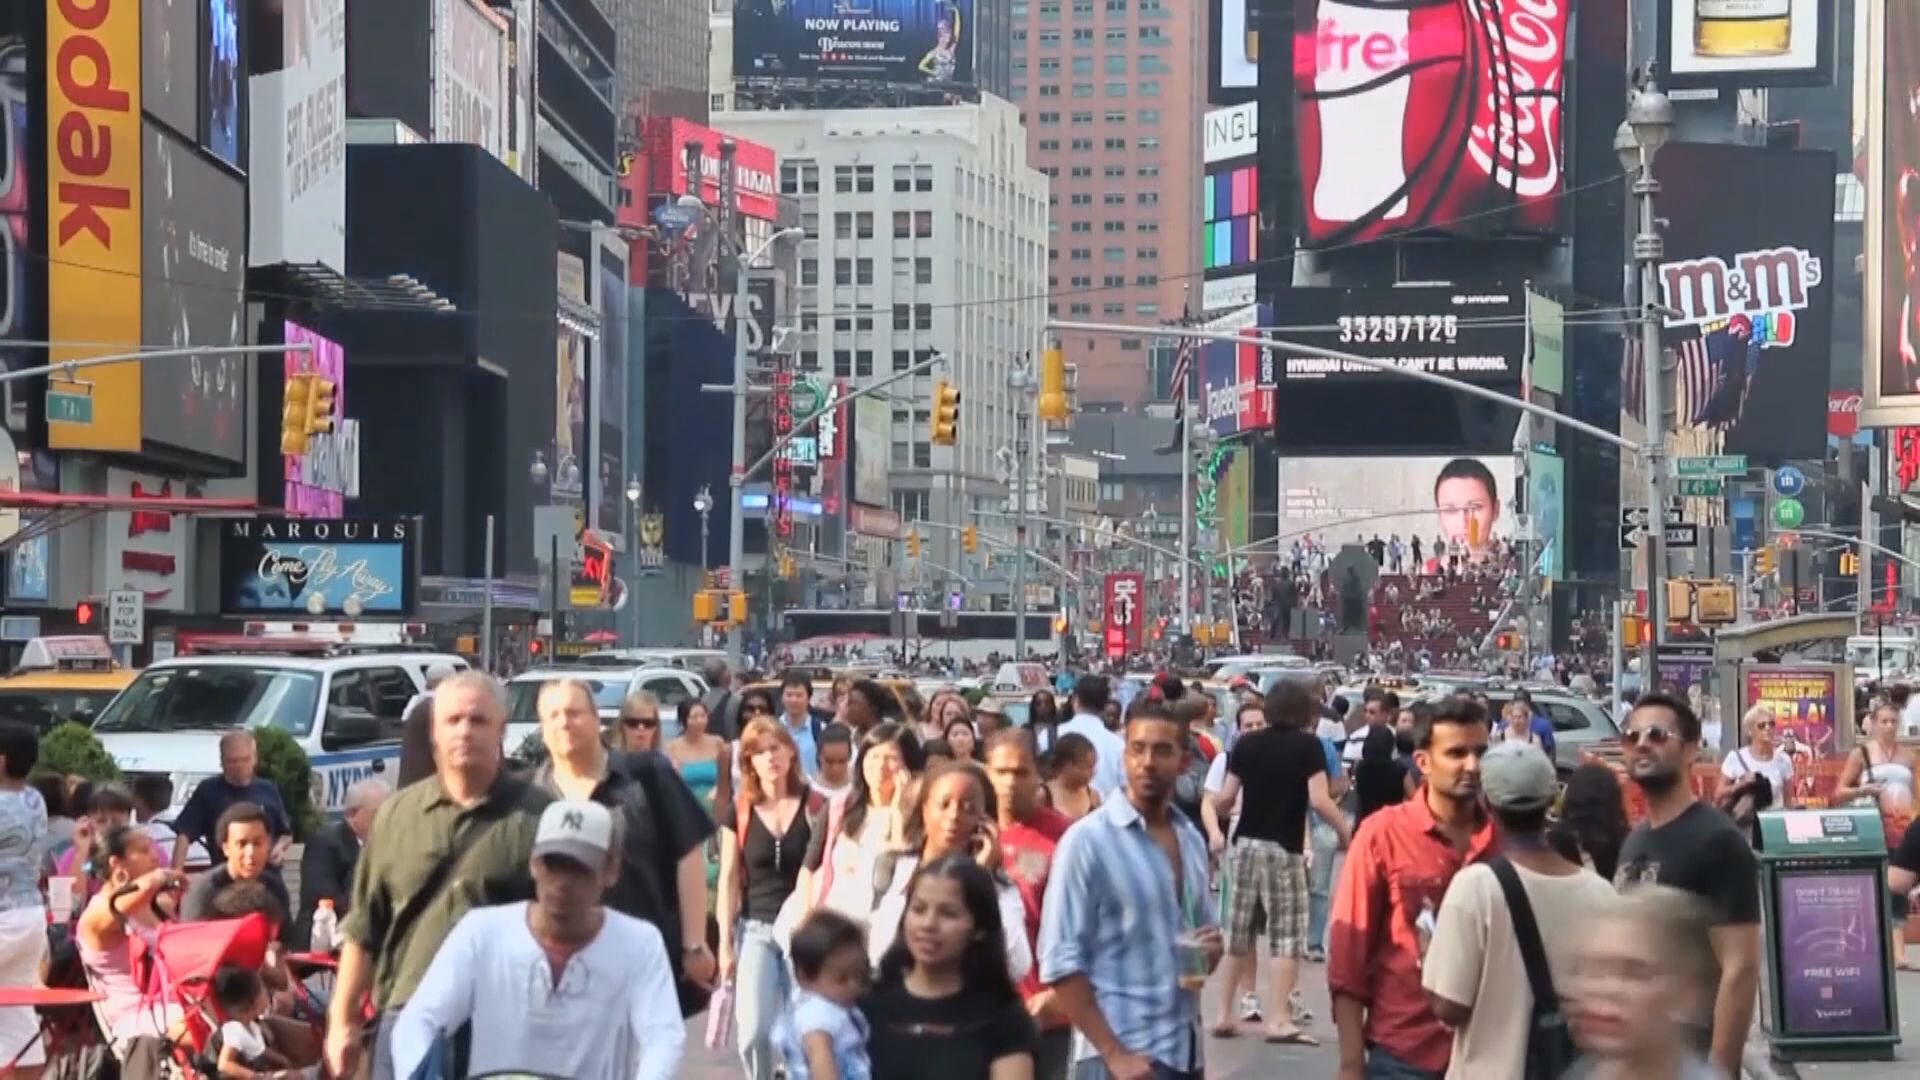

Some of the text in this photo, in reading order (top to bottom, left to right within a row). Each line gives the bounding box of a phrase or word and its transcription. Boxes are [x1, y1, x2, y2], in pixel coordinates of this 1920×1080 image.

[805, 18, 900, 32] NOW PLAYING
[1317, 17, 1409, 72] fre
[1286, 357, 1341, 372] HYUNDAI
[1398, 357, 1436, 371] CAN'T
[1438, 357, 1454, 371] BE
[1456, 357, 1509, 371] WRONG.
[1692, 480, 1706, 495] 45
[233, 522, 406, 539] MARQUIS
[258, 544, 394, 601] Come Fly Away
[116, 595, 137, 604] WAIT
[117, 607, 135, 616] FOR
[114, 618, 137, 628] WALK
[1803, 968, 1833, 978] FREE
